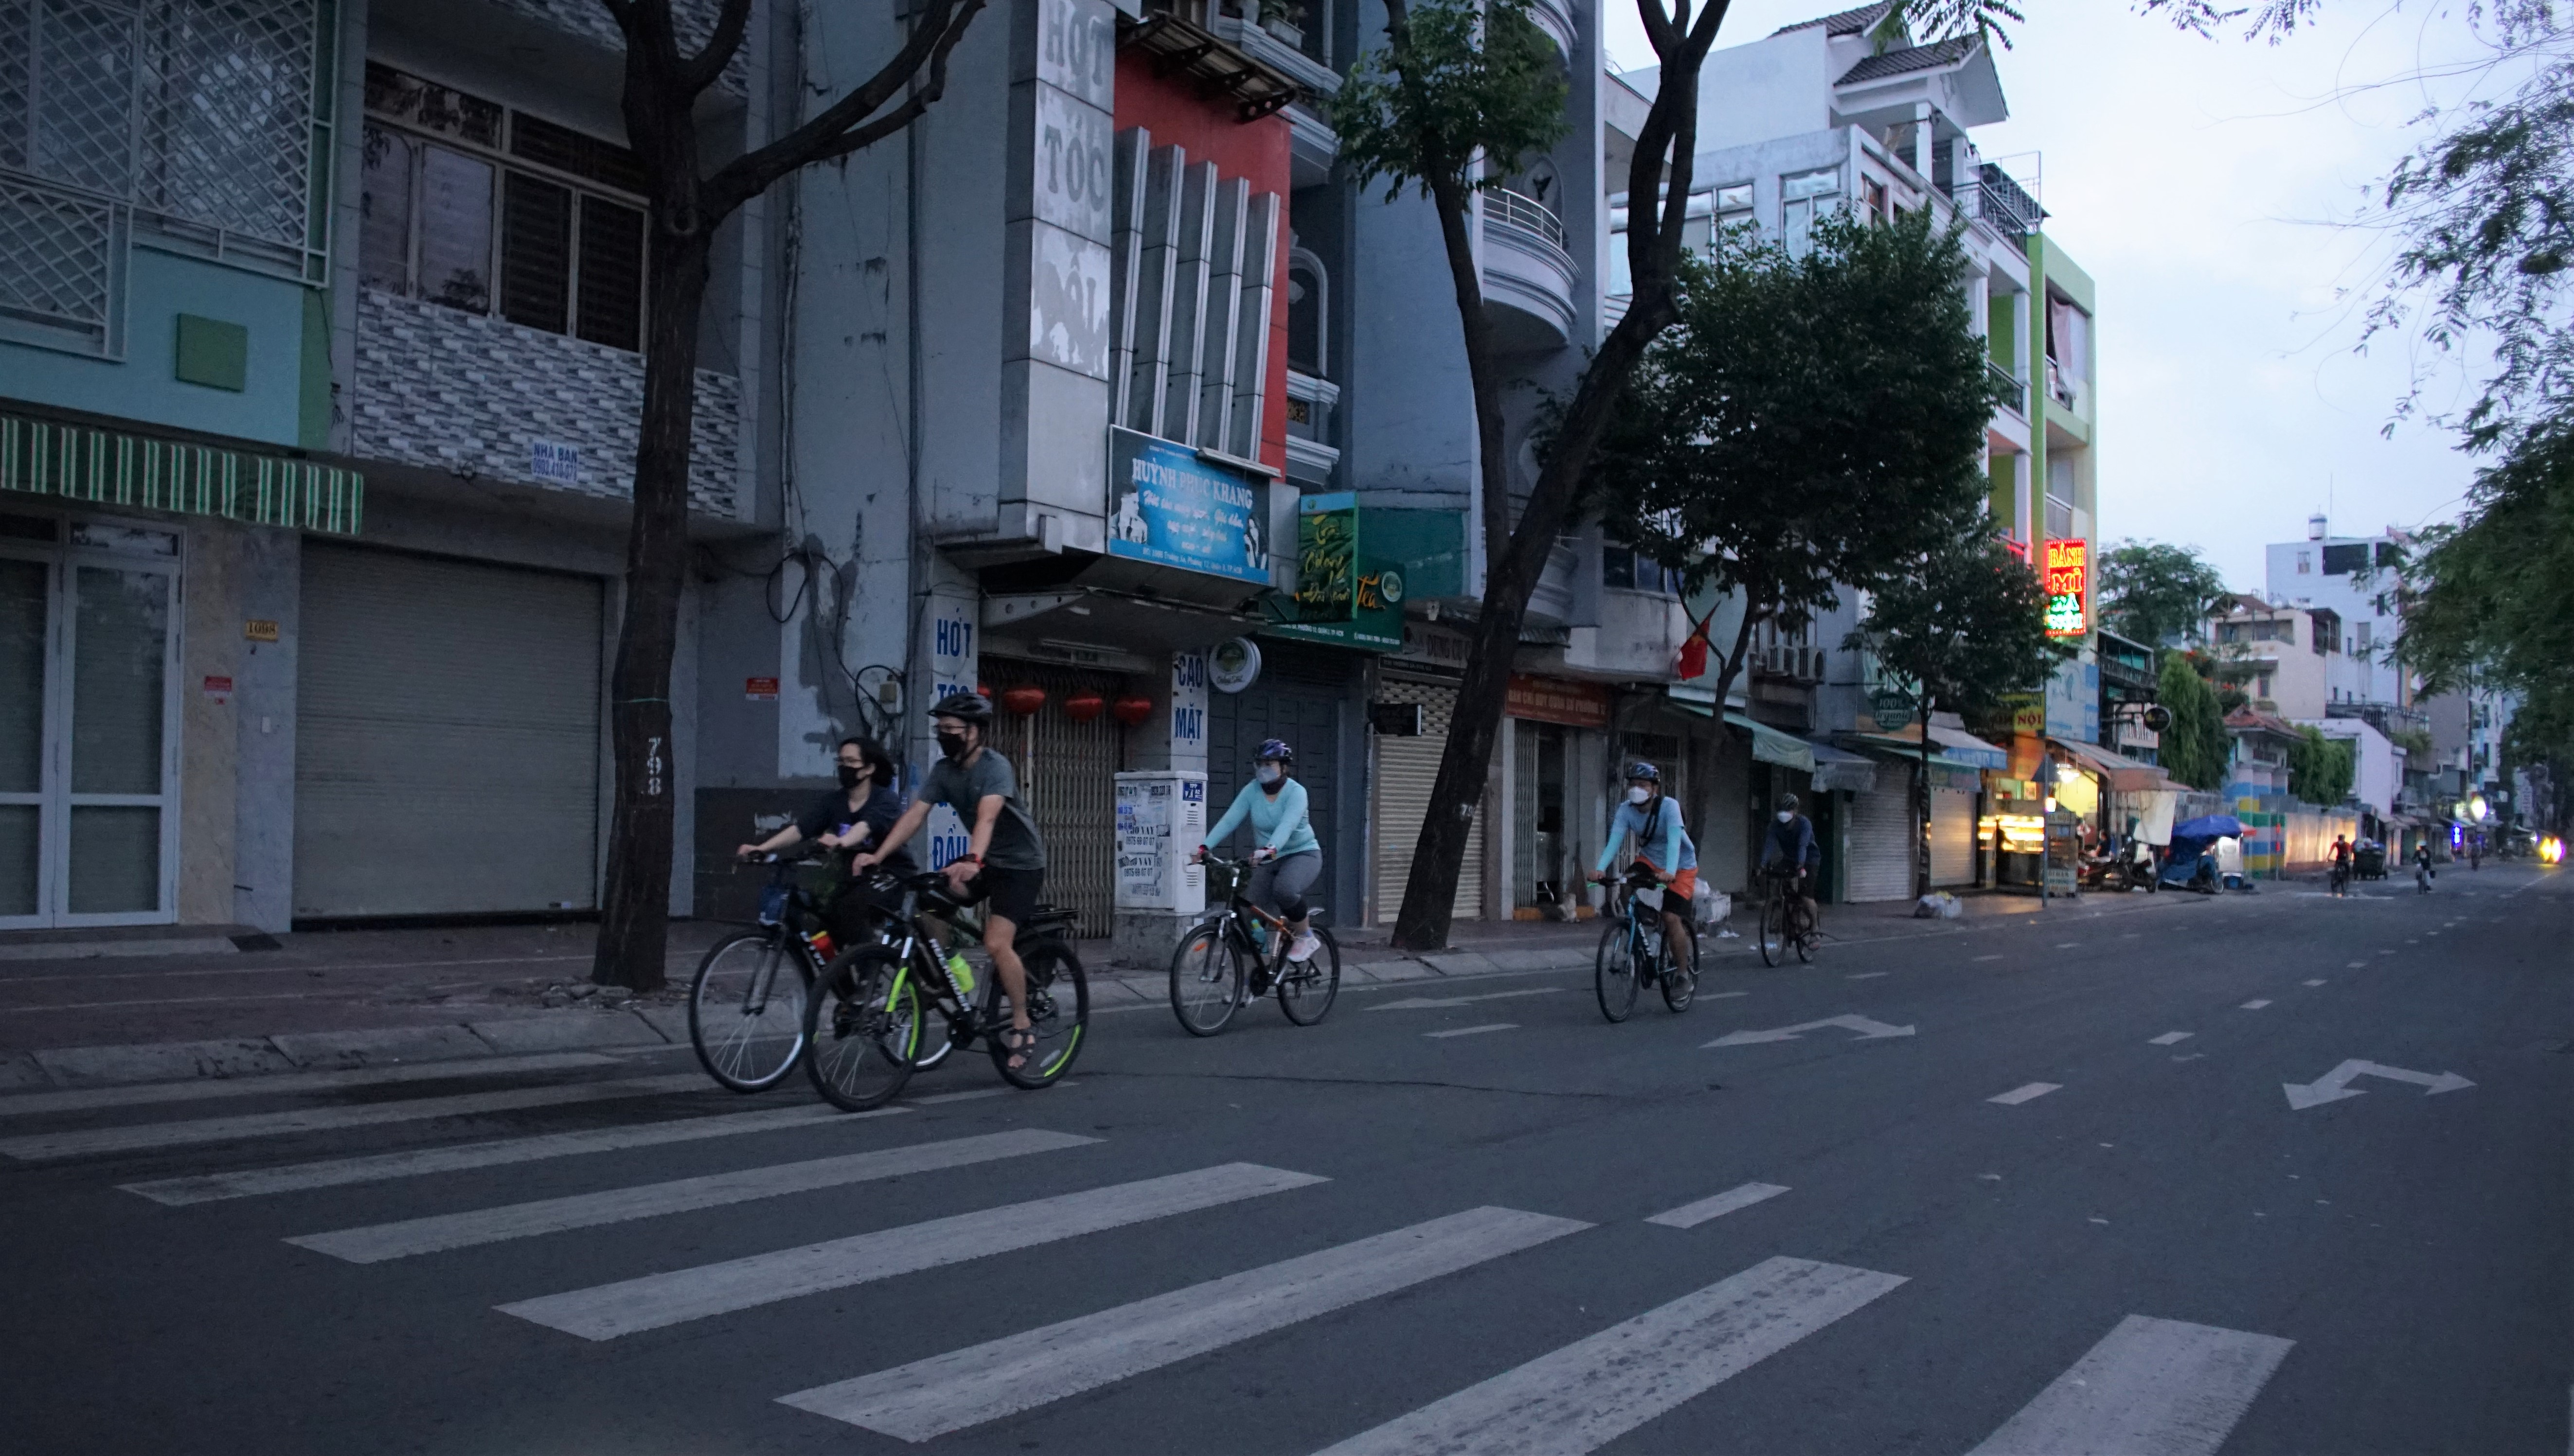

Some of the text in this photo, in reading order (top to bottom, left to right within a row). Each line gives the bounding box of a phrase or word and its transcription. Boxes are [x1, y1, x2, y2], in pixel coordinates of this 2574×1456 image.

[1213, 480, 1253, 510] KHANG
[2050, 542, 2084, 568] BÁNH
[1178, 655, 1203, 693] CẠO
[1175, 702, 1202, 745] MẶT
[2018, 712, 2041, 728] NỘI
